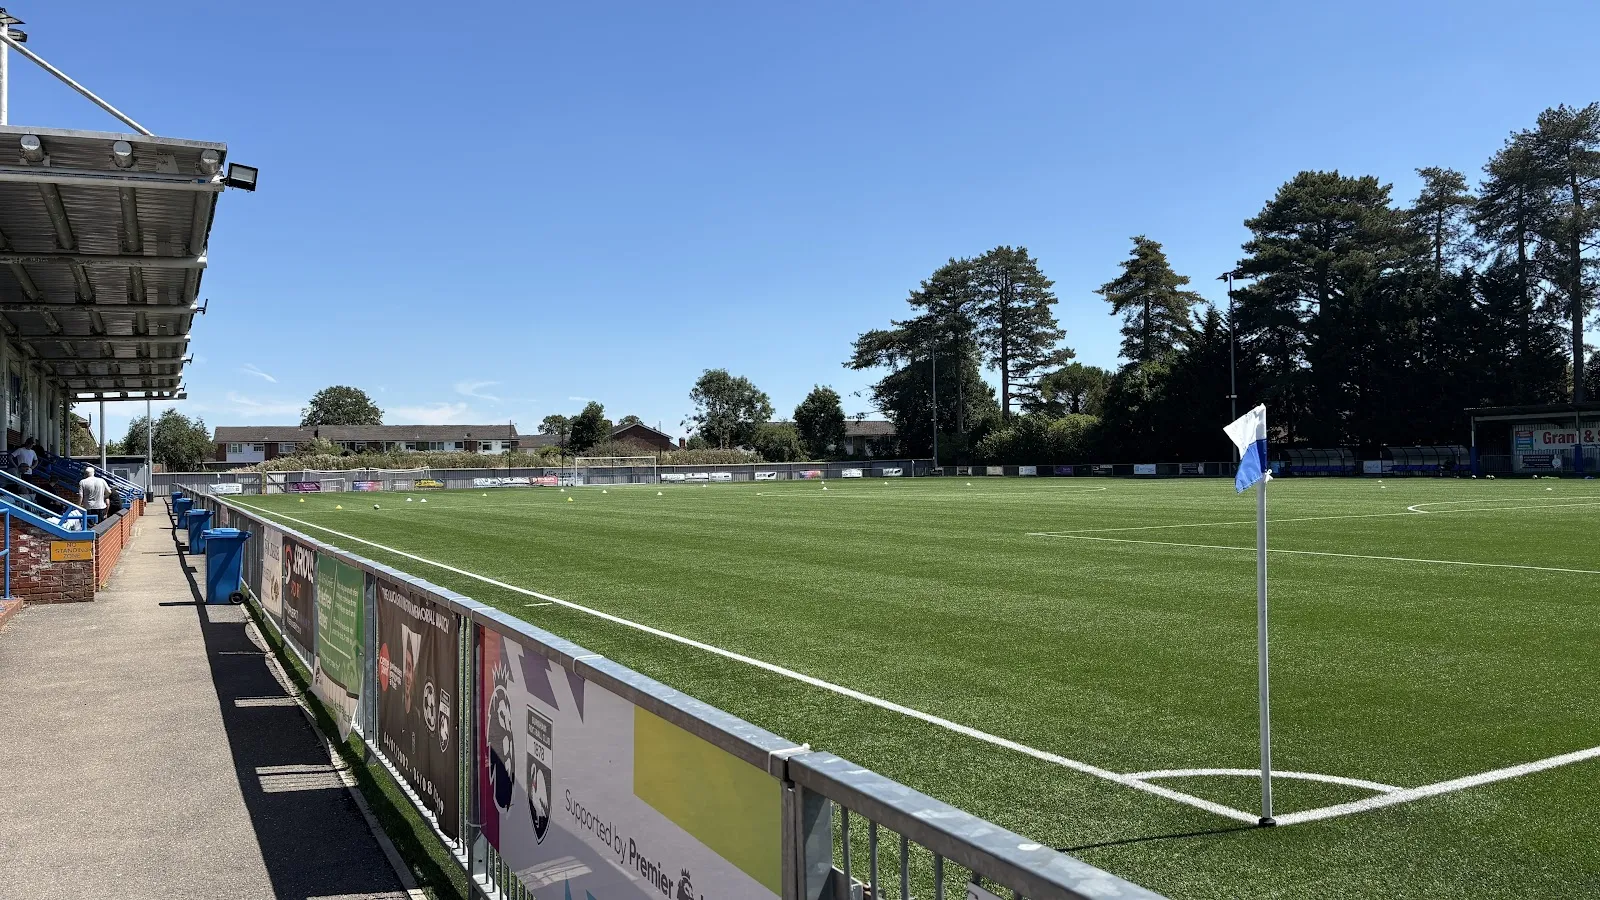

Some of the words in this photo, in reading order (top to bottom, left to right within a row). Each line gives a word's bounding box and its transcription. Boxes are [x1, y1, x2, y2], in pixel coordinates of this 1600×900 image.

[1543, 431, 1577, 444] Gran
[1584, 429, 1594, 443] &
[565, 788, 612, 848] Supported
[614, 825, 627, 865] by
[629, 837, 674, 899] Premier
